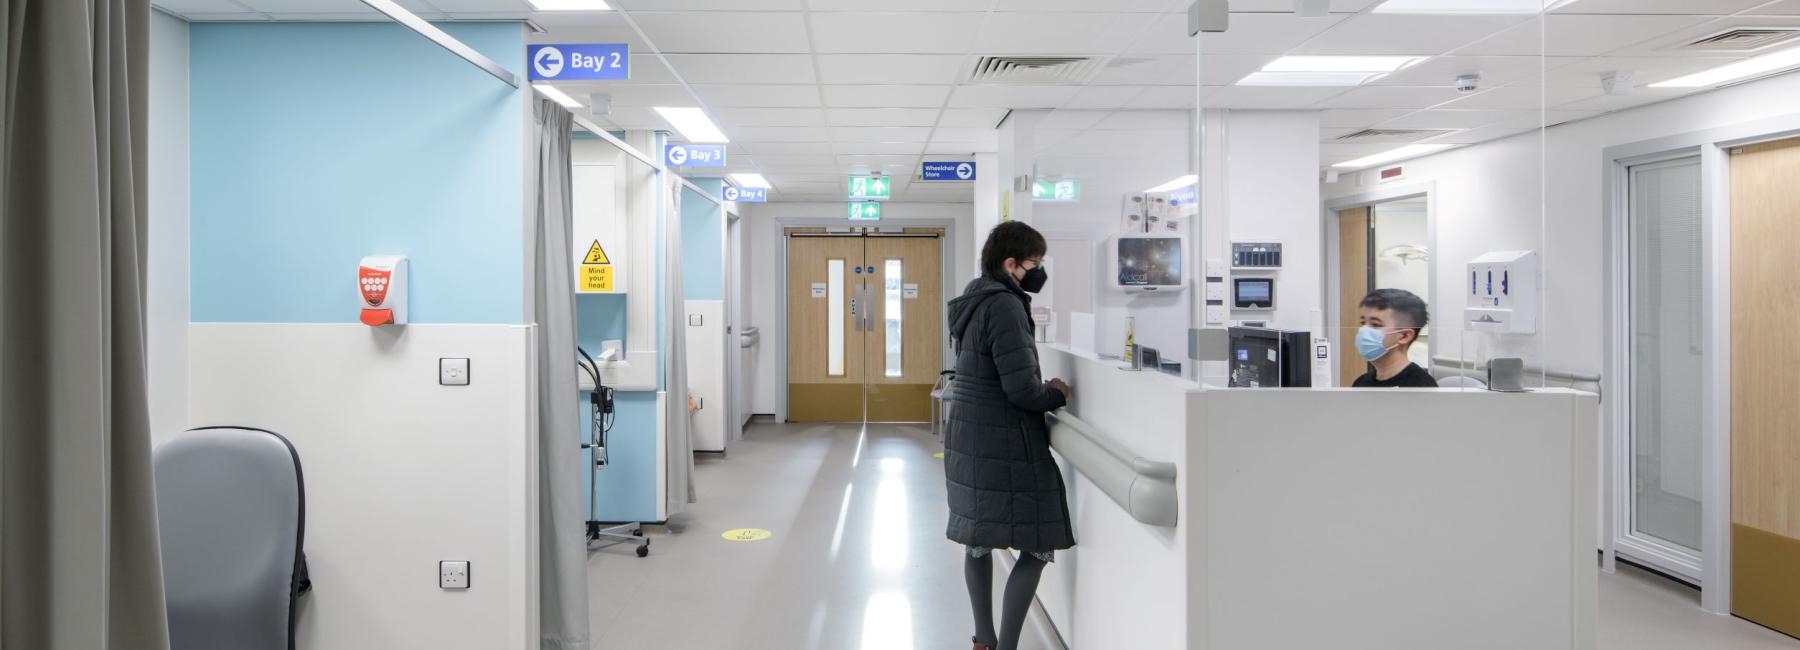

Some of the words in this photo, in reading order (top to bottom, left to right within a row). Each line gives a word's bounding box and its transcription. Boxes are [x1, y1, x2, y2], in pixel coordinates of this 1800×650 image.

[571, 52, 605, 72] Bay
[610, 52, 621, 68] 2
[691, 150, 711, 162] Bay
[713, 150, 720, 160] 3
[740, 190, 756, 199] Bay
[757, 190, 762, 198] 4
